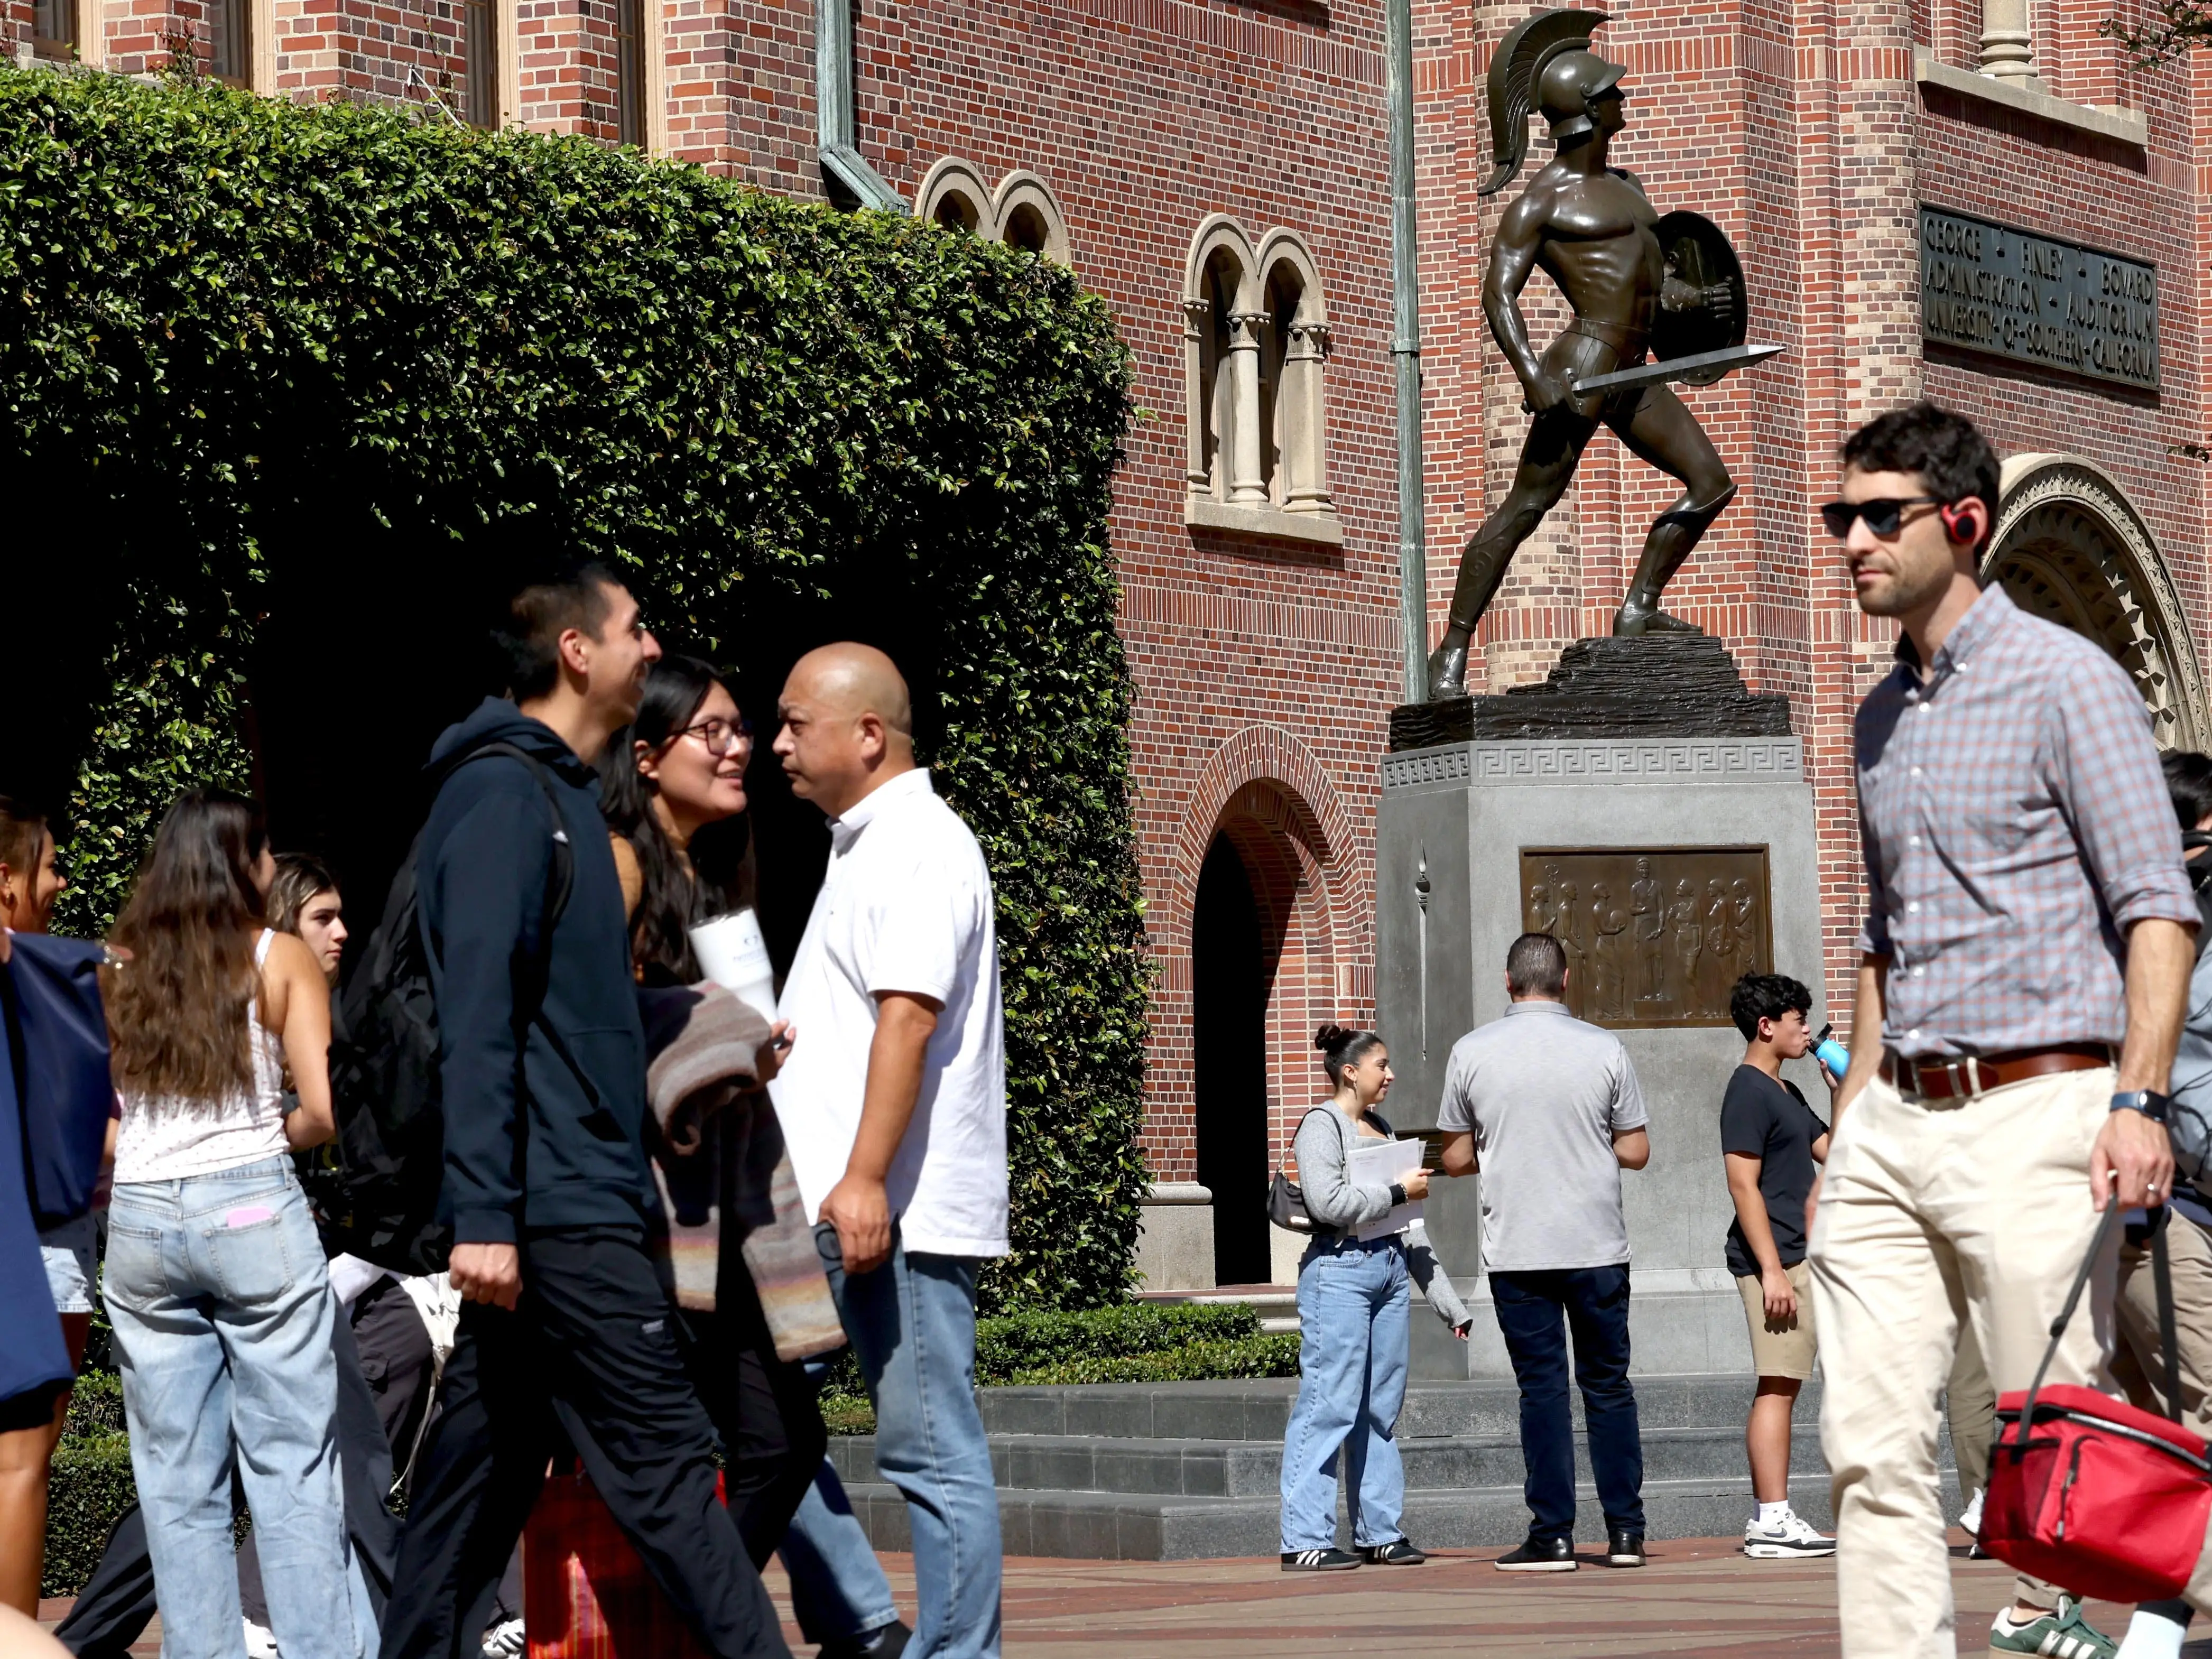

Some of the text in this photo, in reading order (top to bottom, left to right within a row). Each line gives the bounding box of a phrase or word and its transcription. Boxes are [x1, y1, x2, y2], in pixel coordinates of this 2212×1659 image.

[1925, 216, 2152, 304] GEORGE FINLEY BOVARD
[1926, 258, 2153, 344] ADMINISTRATION AUDITORIUM
